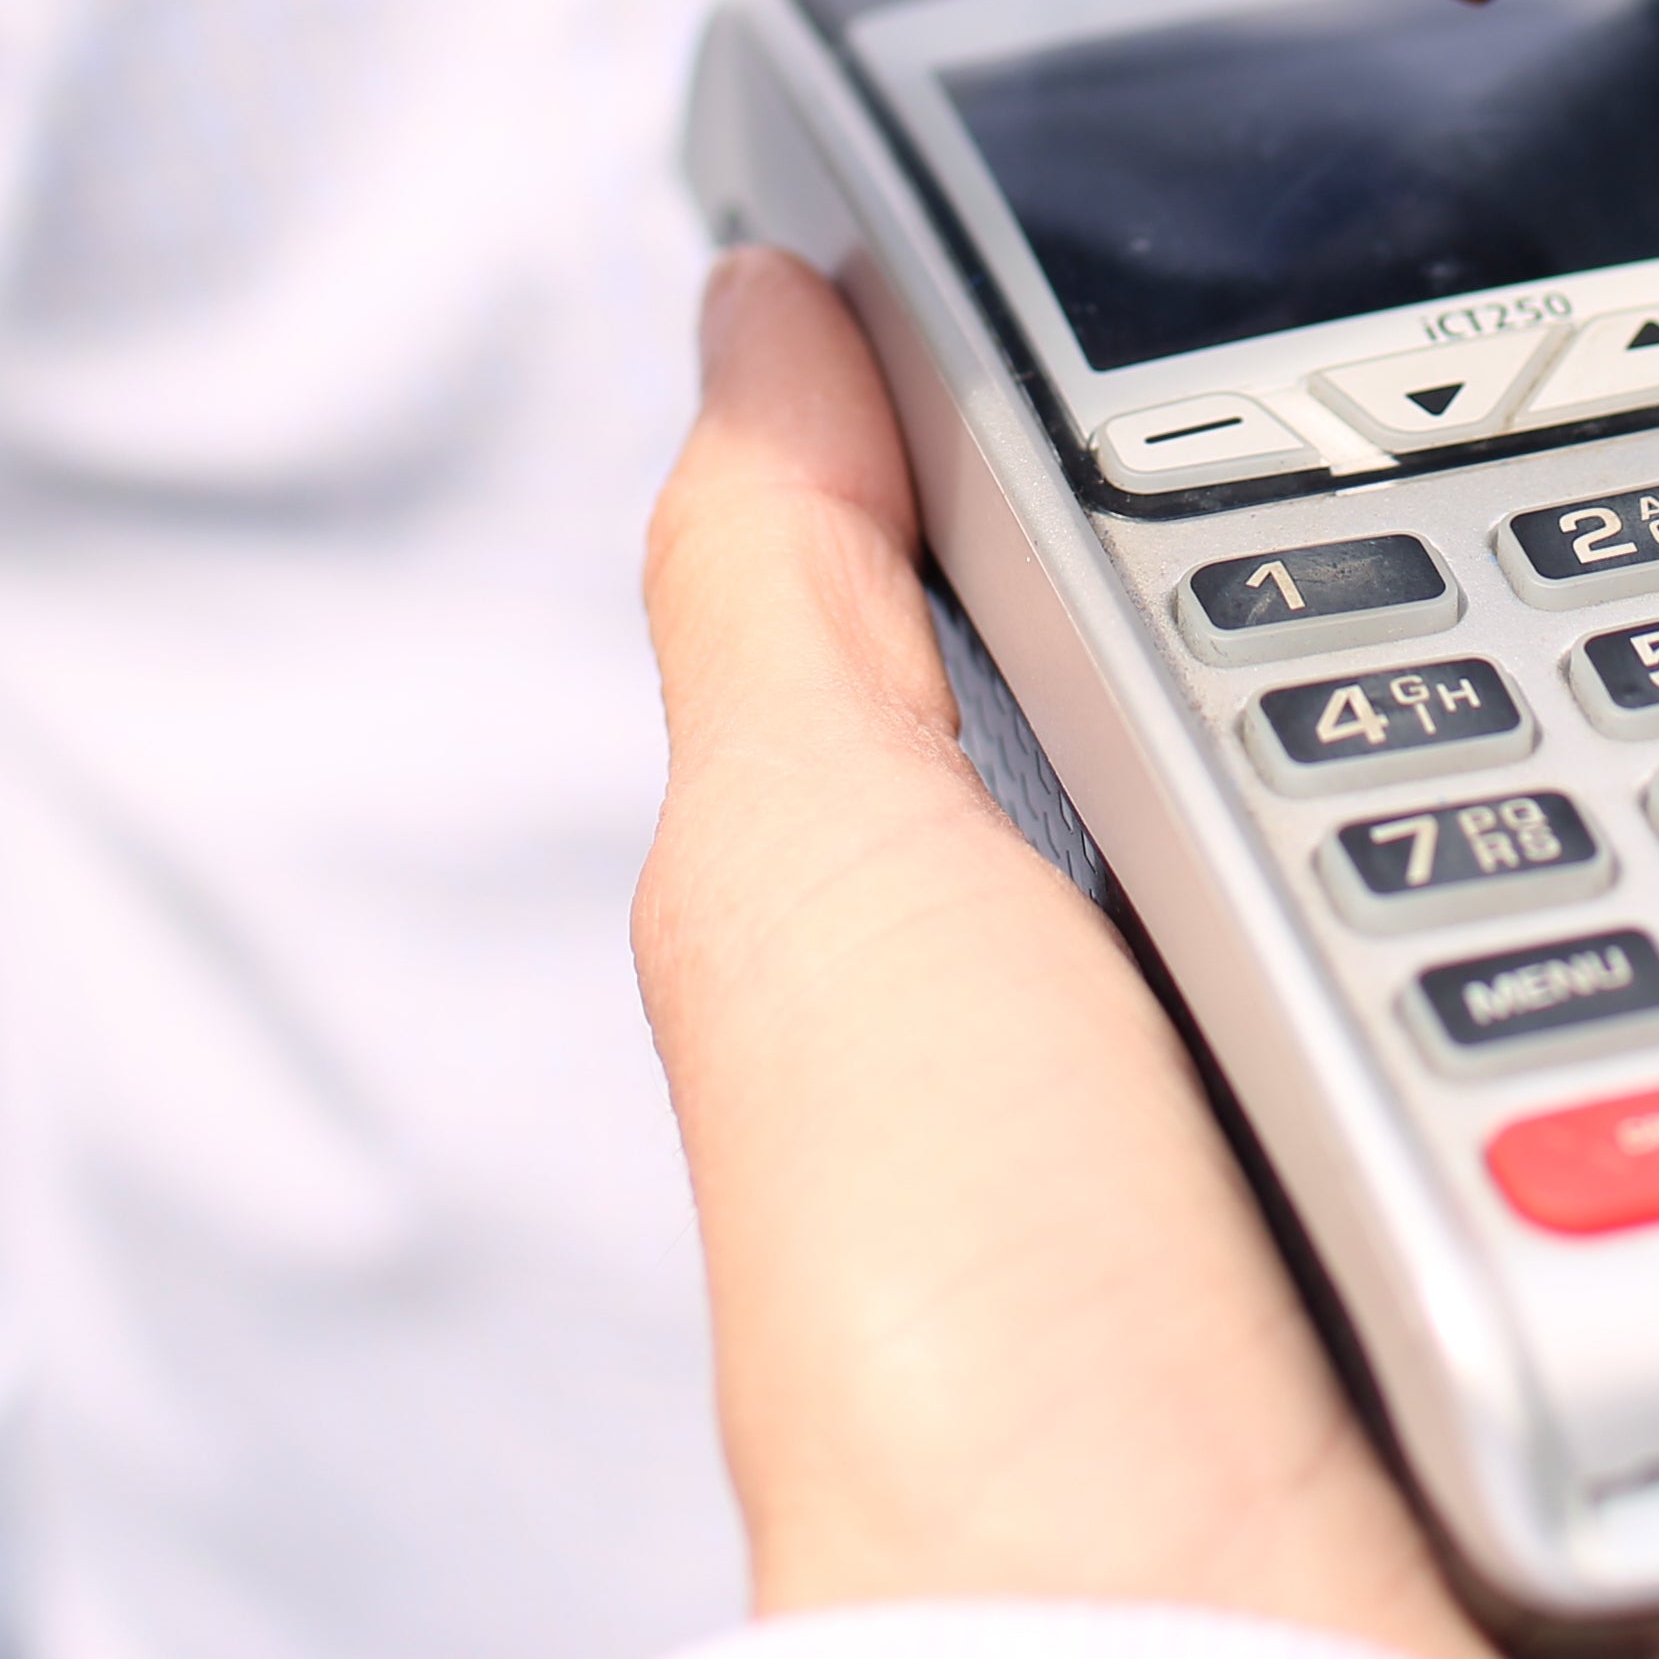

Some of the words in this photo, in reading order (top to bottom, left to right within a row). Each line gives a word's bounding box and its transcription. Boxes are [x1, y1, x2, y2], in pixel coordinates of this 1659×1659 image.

[1420, 292, 1573, 342] iCT250
[1559, 507, 1638, 564] 2
[1245, 560, 1306, 611] 1
[1315, 684, 1390, 746] 4
[1370, 814, 1439, 887] 7
[1463, 946, 1635, 1026] MENU
